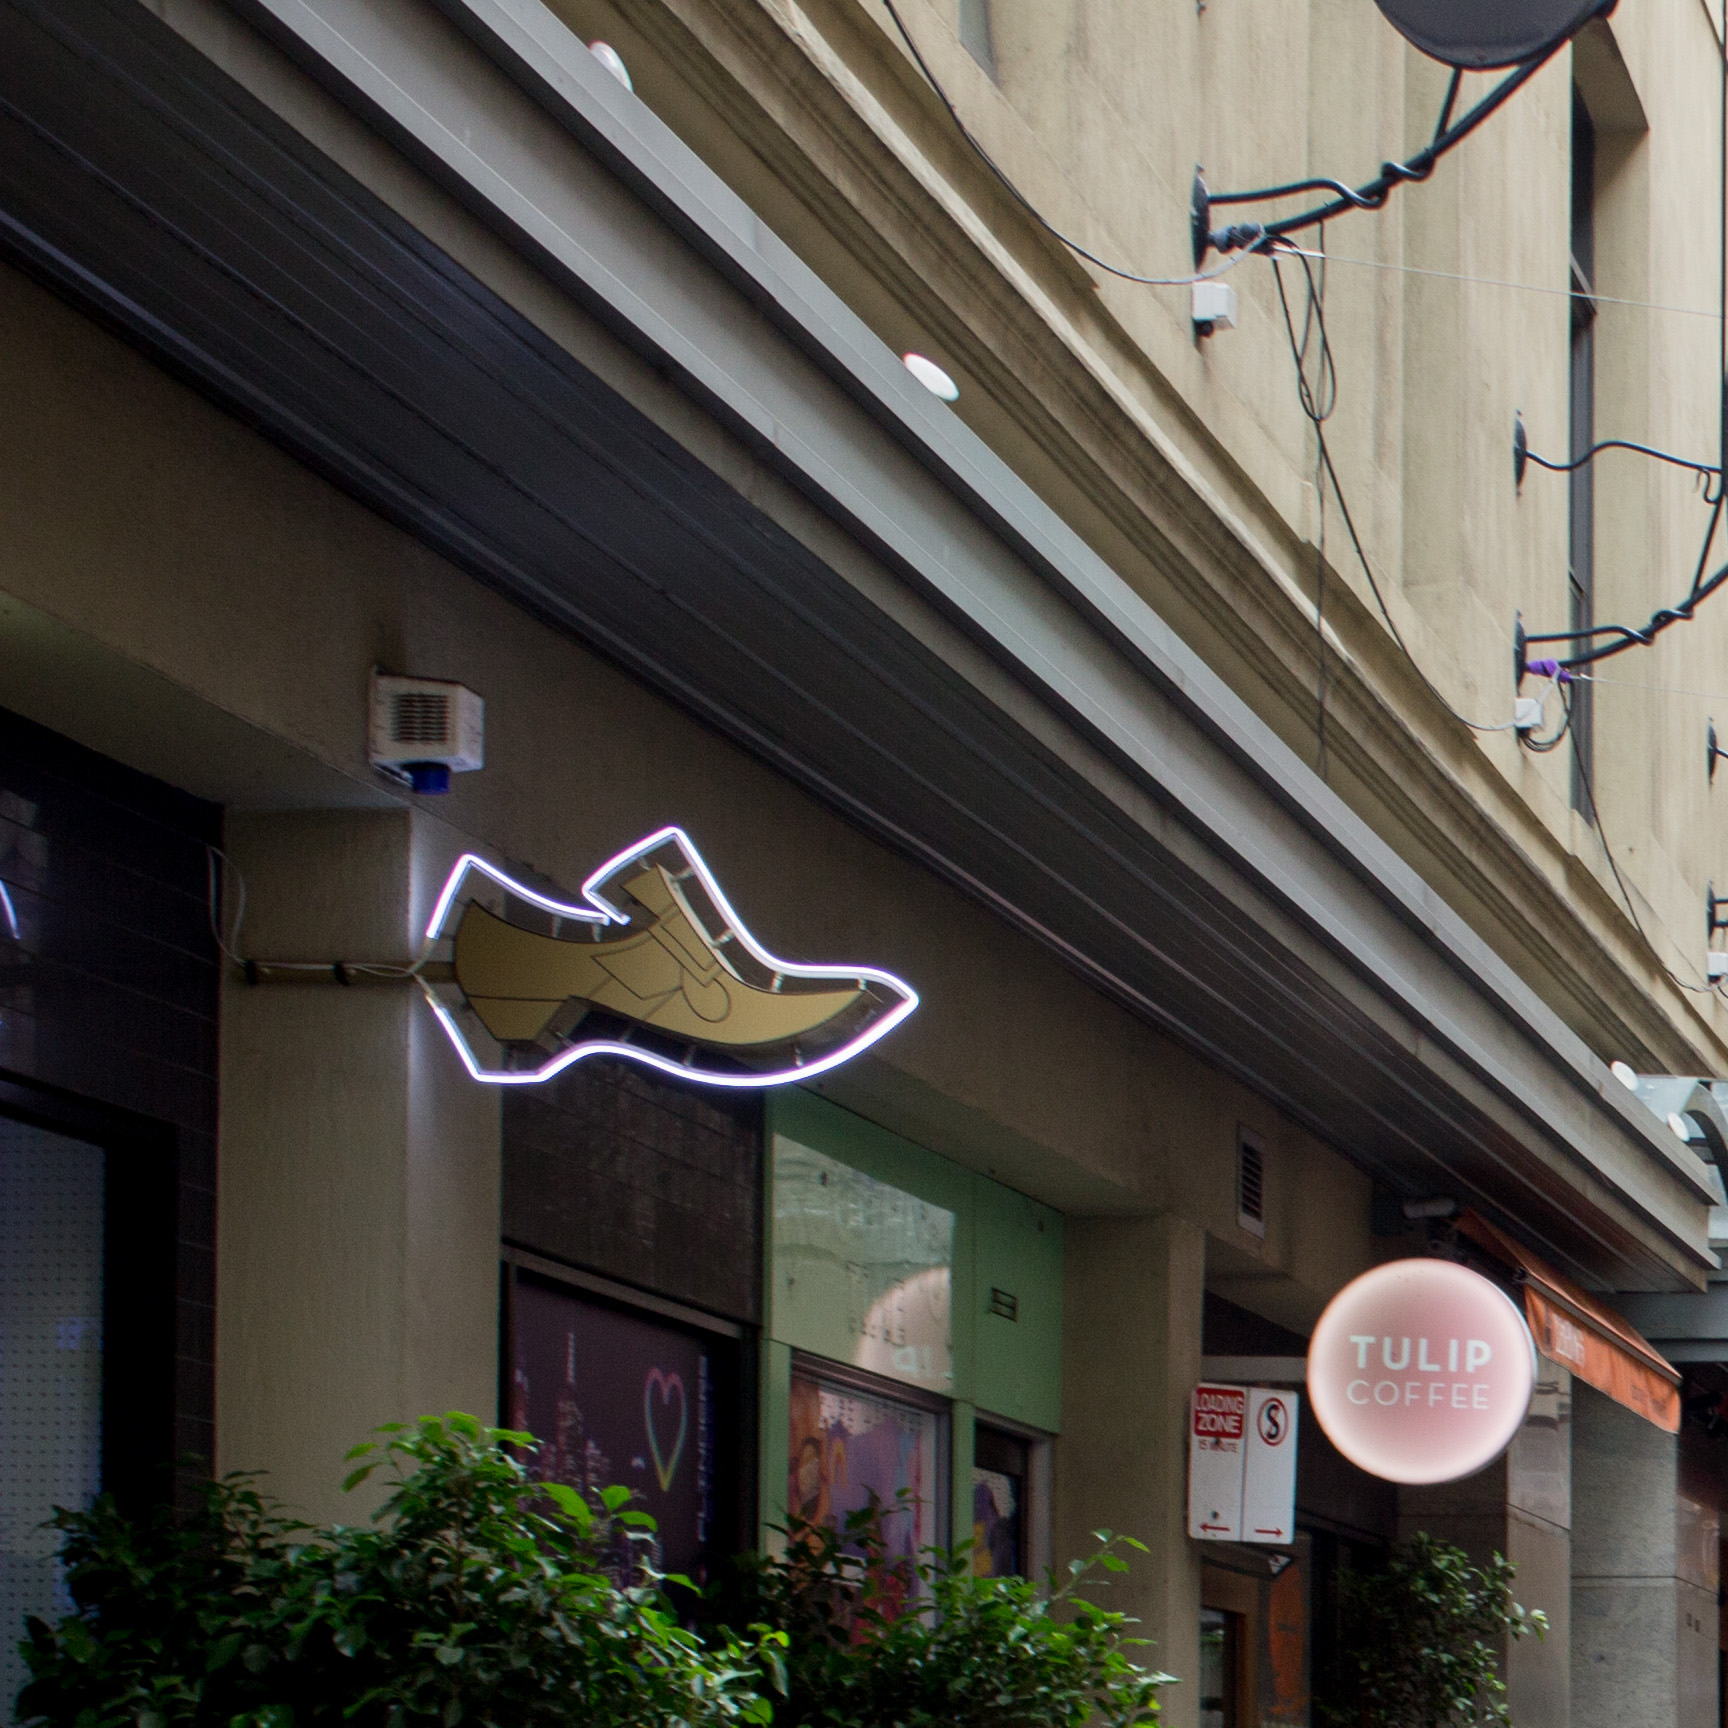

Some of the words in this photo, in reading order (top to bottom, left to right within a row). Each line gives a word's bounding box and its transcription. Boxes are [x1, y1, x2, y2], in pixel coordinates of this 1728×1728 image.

[1350, 1335, 1492, 1373] TULIP
[1197, 1393, 1244, 1414] LOADING
[1347, 1379, 1490, 1410] COFFEE
[1197, 1412, 1241, 1434] ZONE
